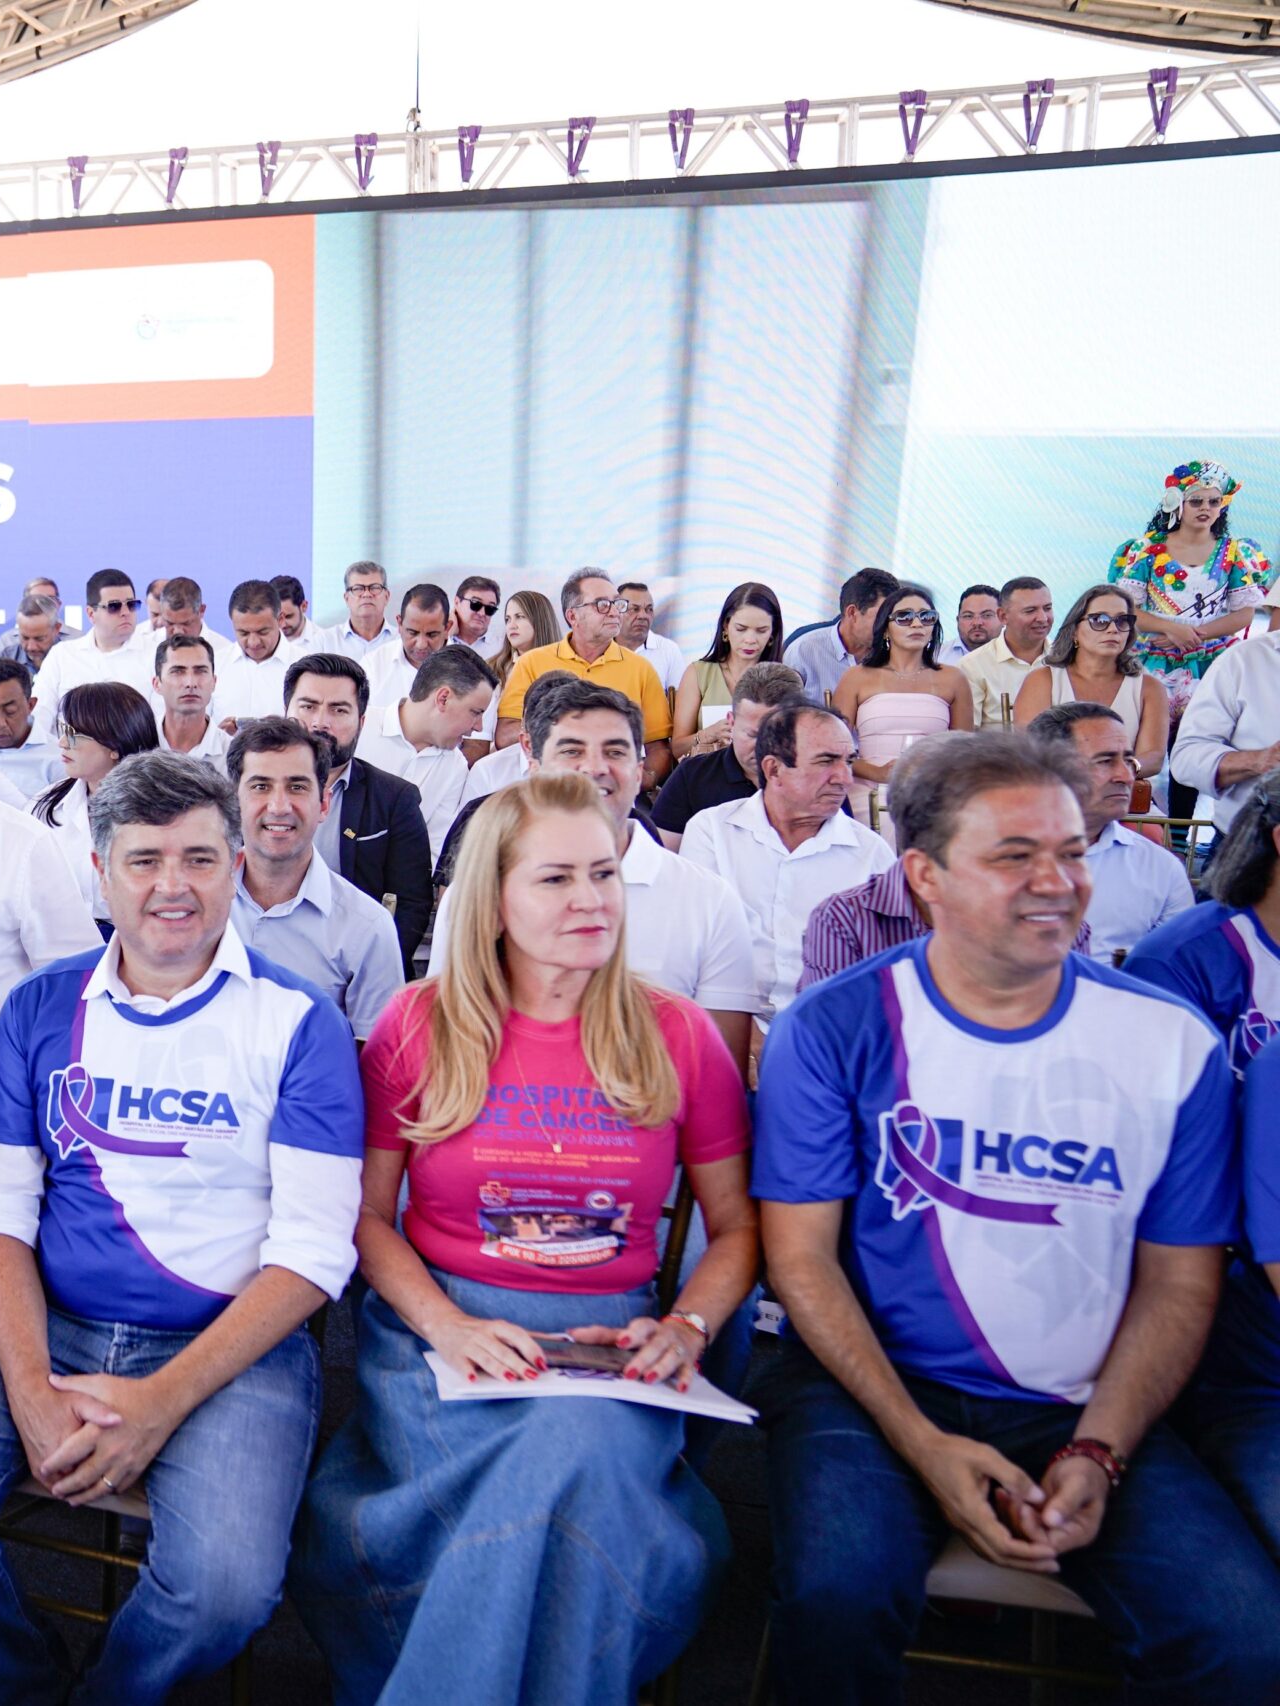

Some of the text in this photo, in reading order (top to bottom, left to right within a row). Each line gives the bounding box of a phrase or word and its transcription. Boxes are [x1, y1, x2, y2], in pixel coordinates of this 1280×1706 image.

[117, 1085, 240, 1127] HCSA
[476, 1106, 509, 1125] DE
[974, 1129, 1124, 1192] HCSA
